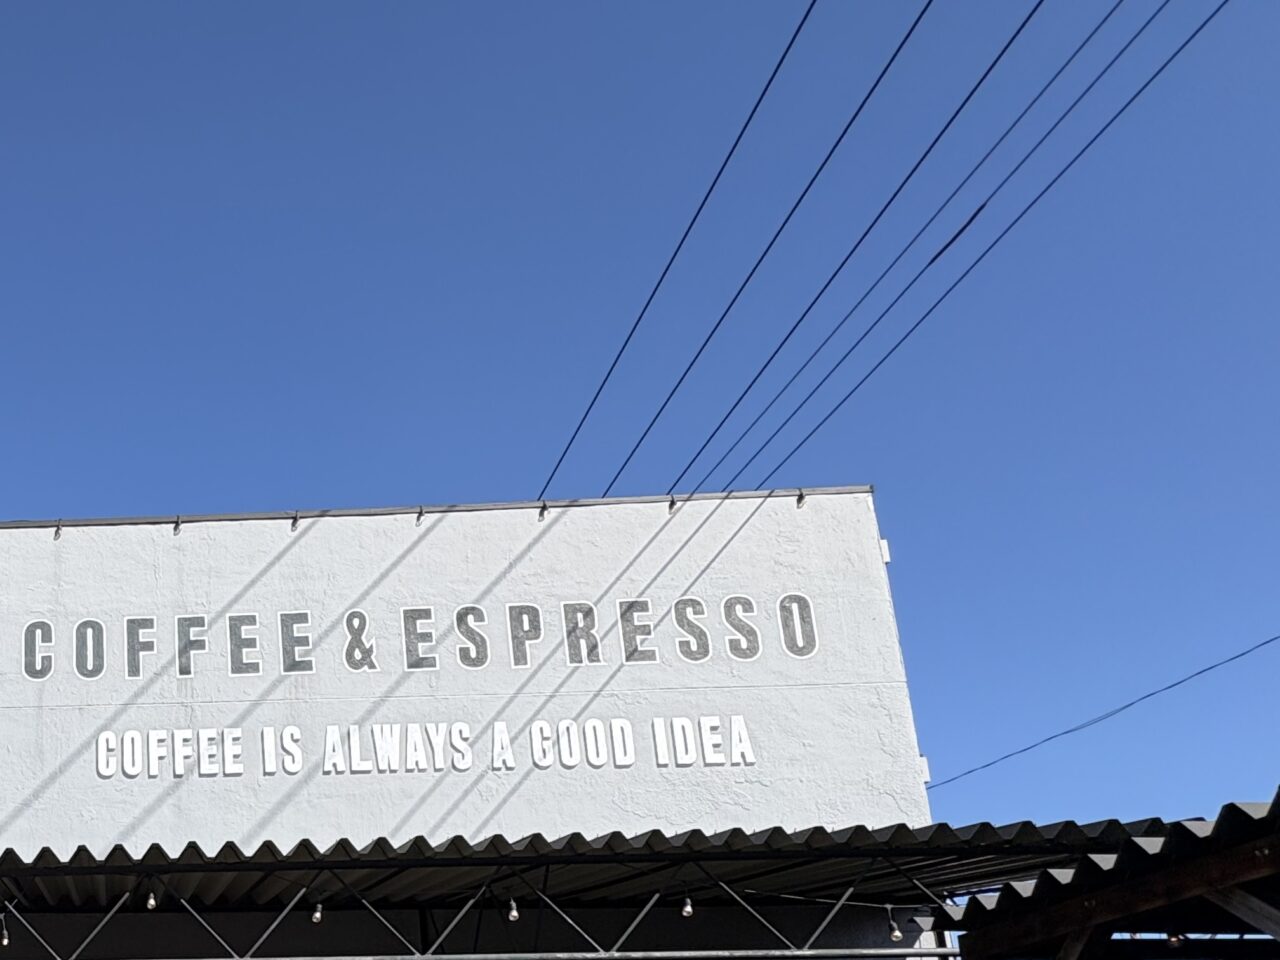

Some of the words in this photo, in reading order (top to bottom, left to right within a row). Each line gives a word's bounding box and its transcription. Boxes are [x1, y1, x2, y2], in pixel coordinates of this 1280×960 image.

[22, 610, 317, 682] COFFEE
[342, 608, 381, 674] &
[401, 592, 819, 678] ESPRESSO
[96, 727, 244, 780] COFFEE
[261, 725, 303, 778] IS
[322, 720, 473, 776] ALWAYS
[491, 721, 517, 772] A
[530, 717, 637, 771] GOOD
[651, 715, 757, 769] IDEA
